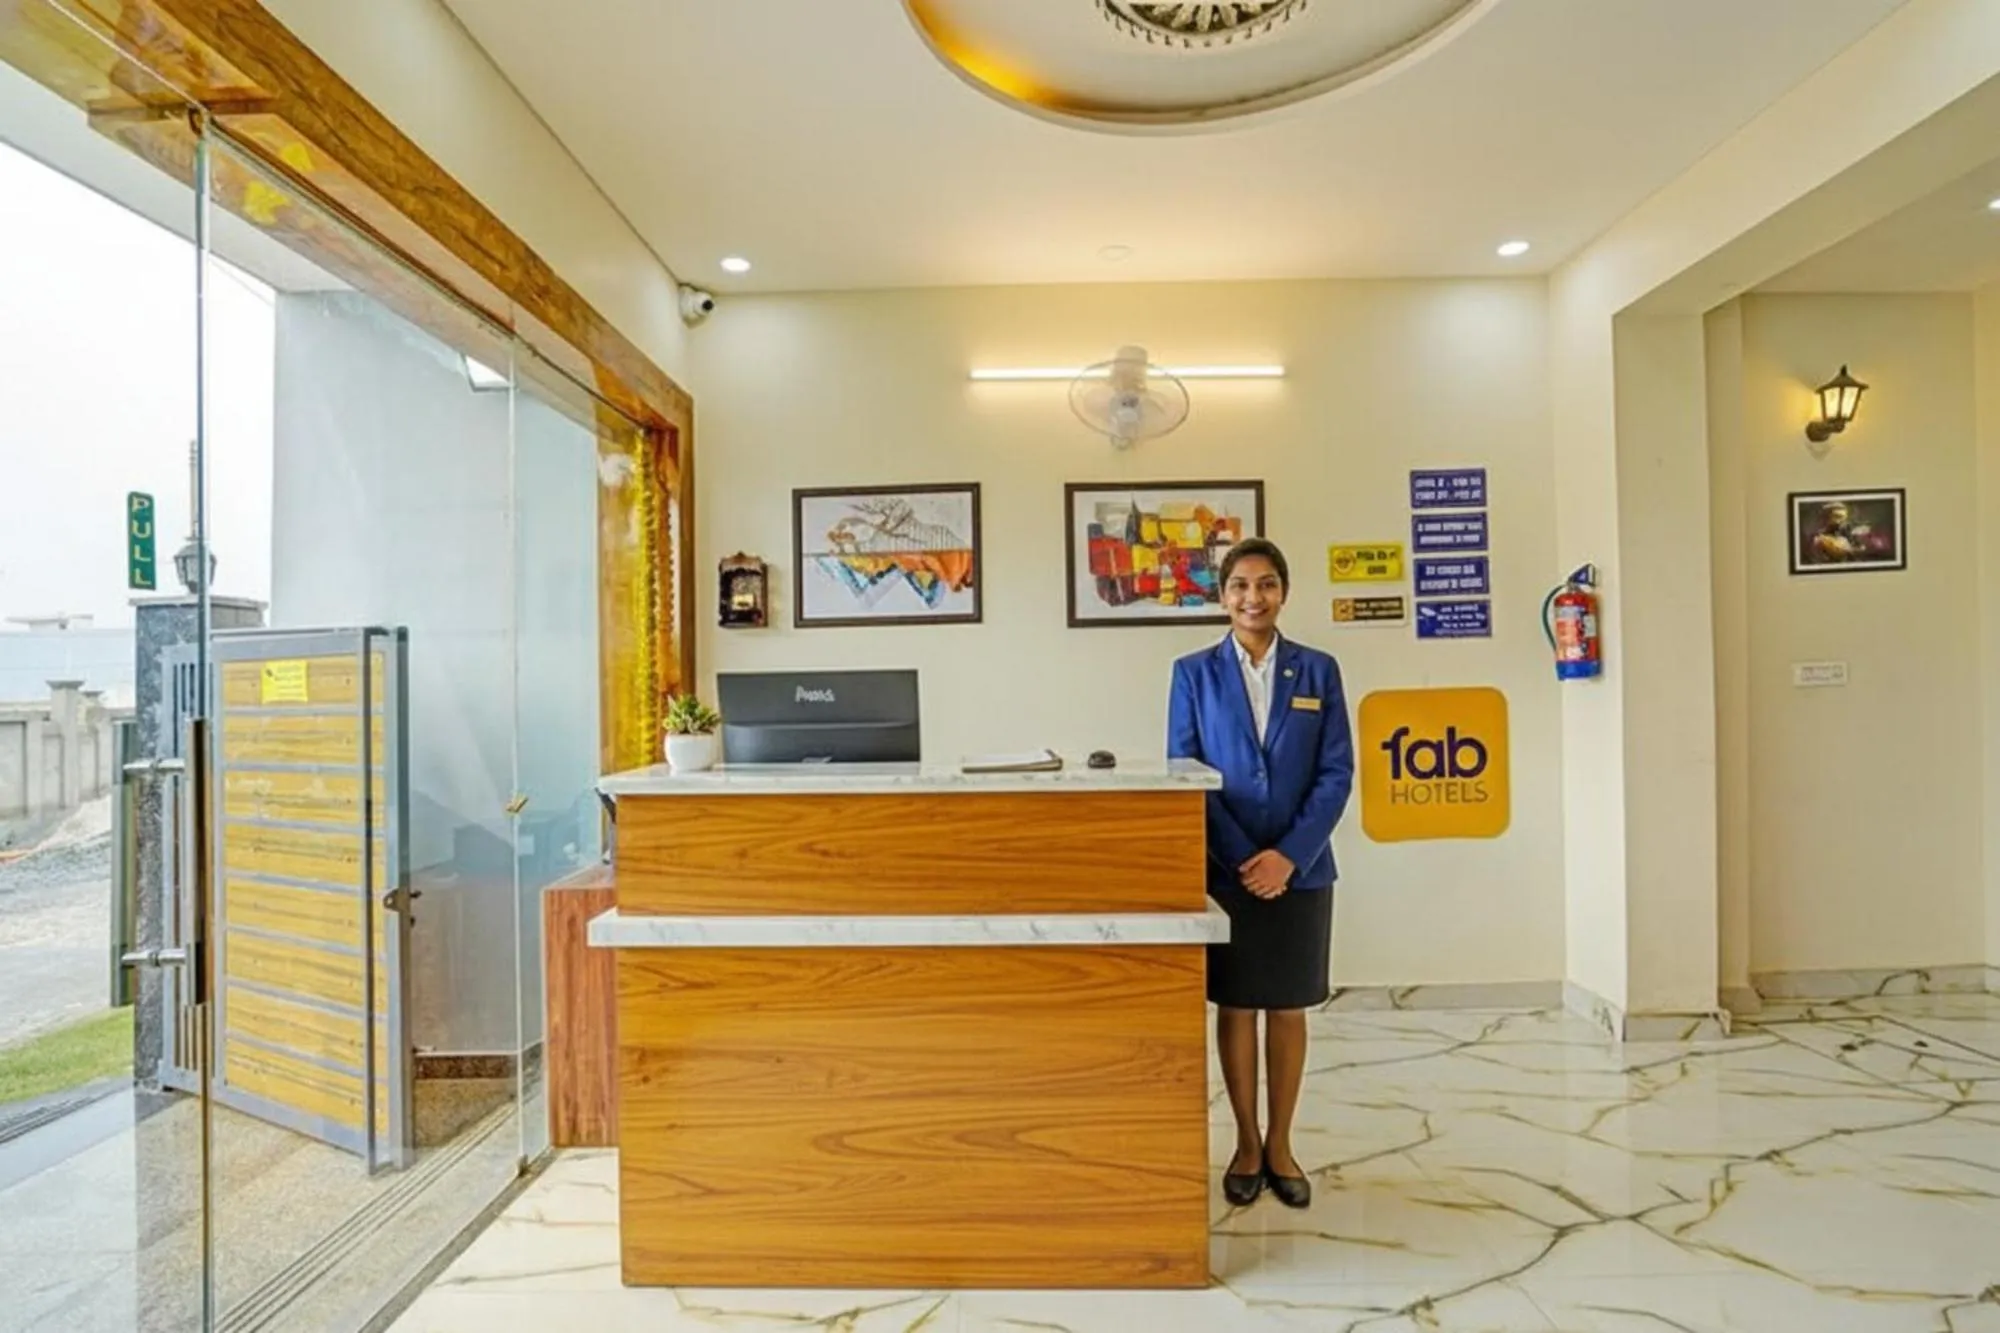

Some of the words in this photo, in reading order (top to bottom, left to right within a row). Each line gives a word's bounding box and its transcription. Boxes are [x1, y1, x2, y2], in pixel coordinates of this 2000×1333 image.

[132, 496, 151, 585] PULL
[1381, 726, 1488, 780] fab
[1390, 781, 1489, 805] HOTELS
